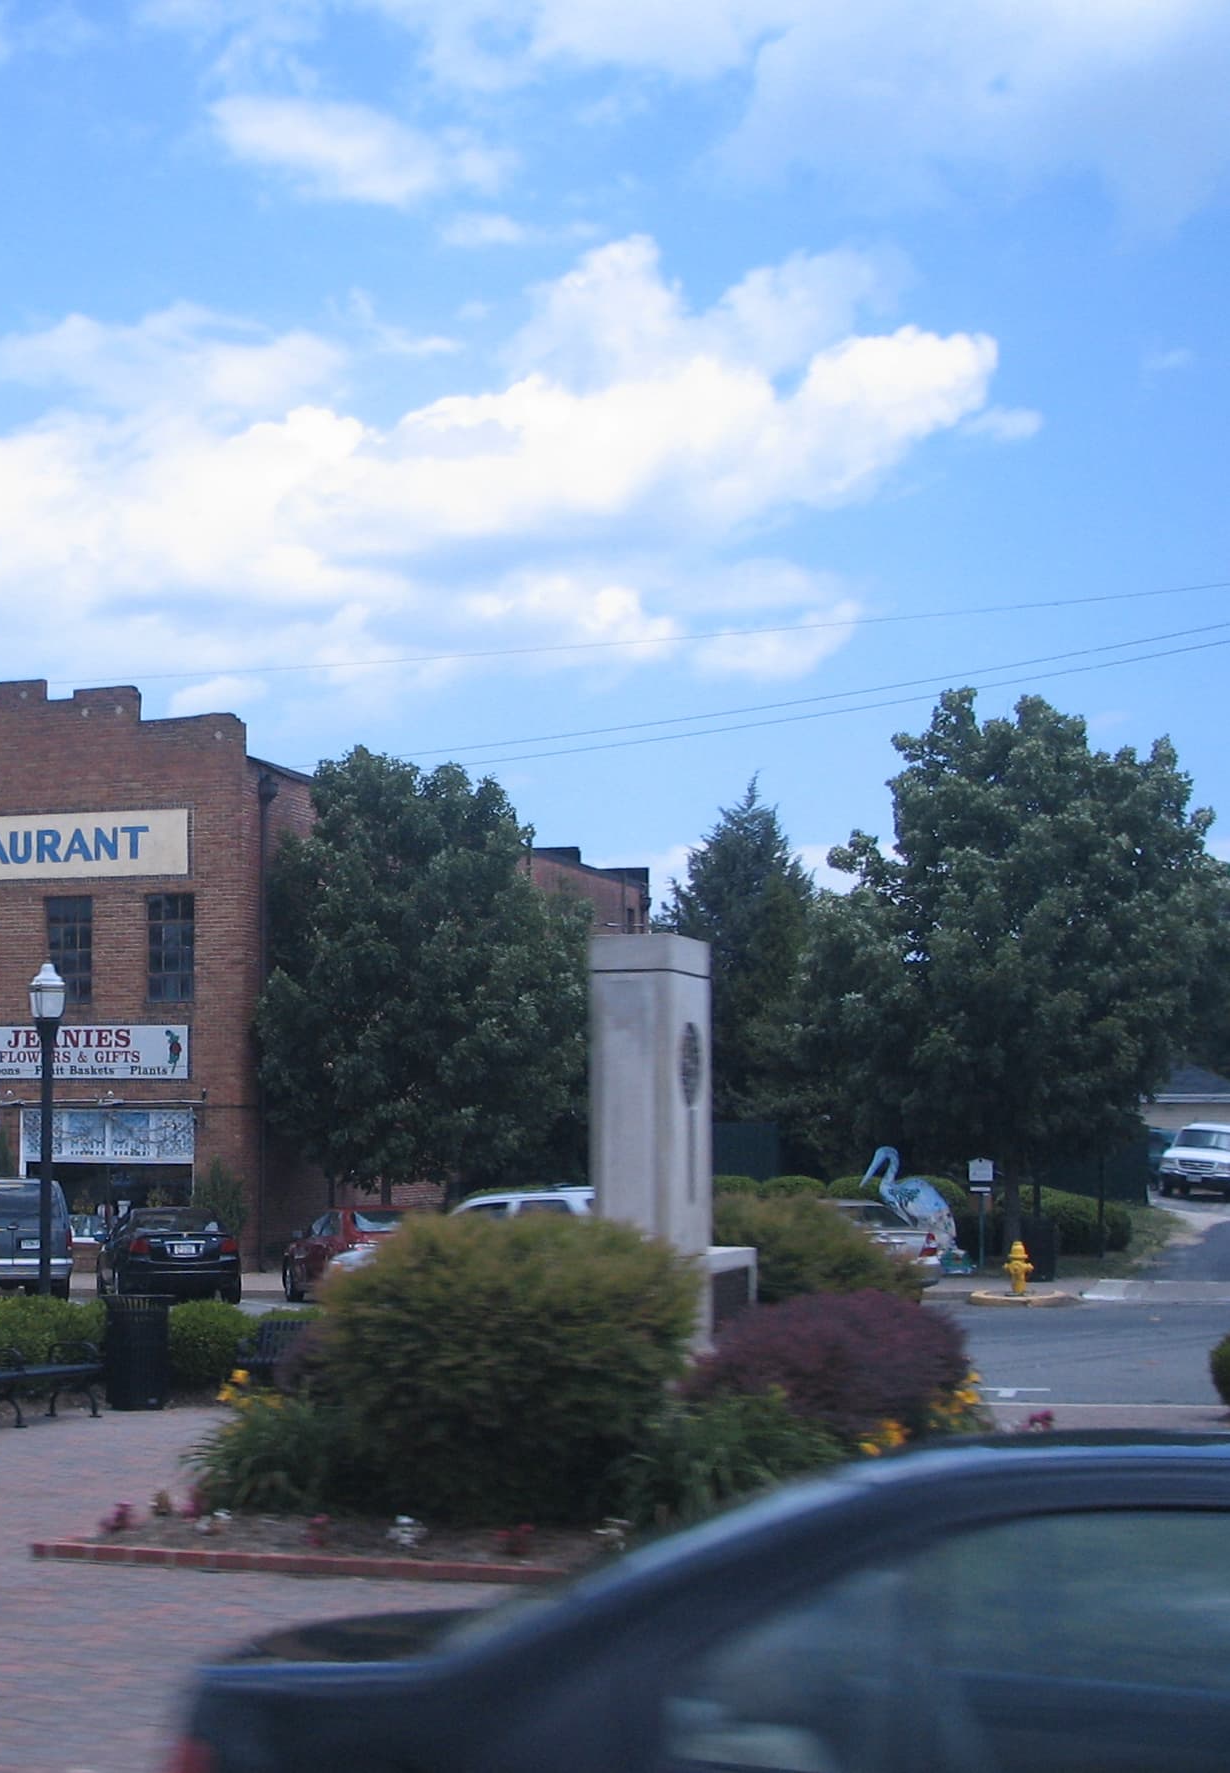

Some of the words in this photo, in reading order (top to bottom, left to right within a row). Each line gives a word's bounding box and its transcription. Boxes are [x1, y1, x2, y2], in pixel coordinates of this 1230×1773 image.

[7, 1029, 131, 1049] JENIES
[0, 1050, 71, 1064] FLOWRS
[77, 1051, 88, 1063] &
[95, 1050, 141, 1063] GIFTS
[34, 1065, 64, 1075] Fit
[69, 1065, 115, 1076] Baskets
[129, 1065, 168, 1076] Plants
